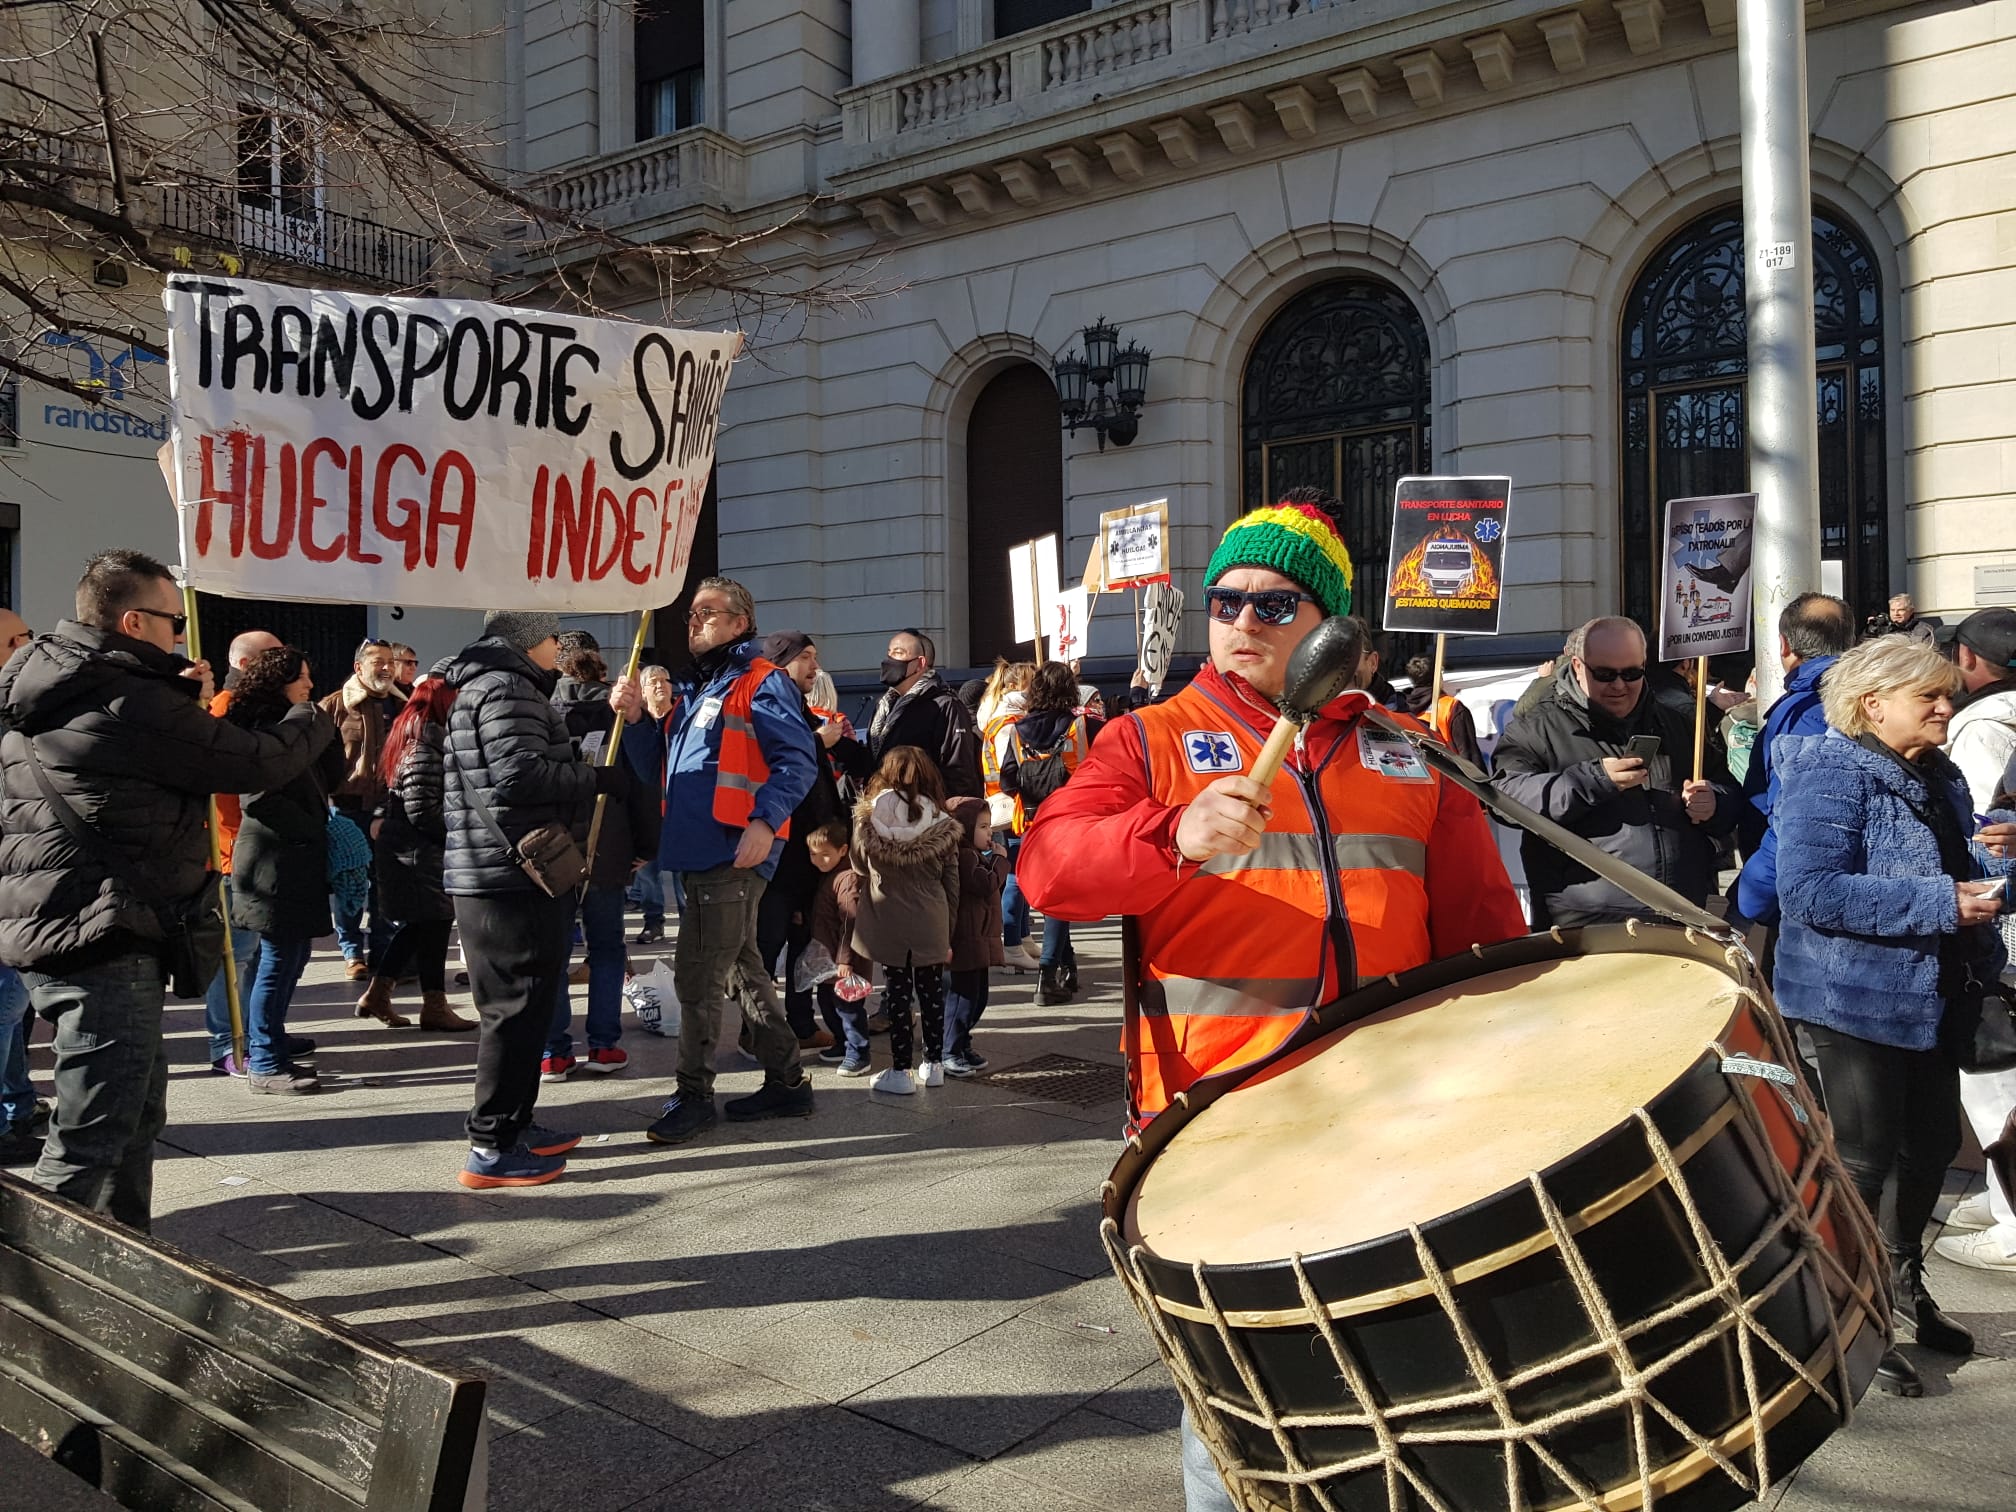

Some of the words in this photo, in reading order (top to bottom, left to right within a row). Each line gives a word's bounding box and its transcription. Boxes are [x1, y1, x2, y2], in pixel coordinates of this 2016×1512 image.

[1766, 257, 1783, 268] 017
[167, 281, 600, 436] TRANSPORTE
[44, 403, 171, 441] randstad
[194, 426, 476, 572] HUELGA
[1400, 500, 1457, 510] TRANSPORTE
[1457, 499, 1504, 509] SANITARIO
[1427, 512, 1441, 521] EN
[1442, 512, 1471, 521] LUCHA
[1726, 519, 1743, 531] POR
[1395, 598, 1438, 609] ¡ESTAMOS
[1438, 599, 1491, 610] QUEMADOS!
[1682, 632, 1692, 644] UN
[1691, 629, 1721, 643] CONVENIO
